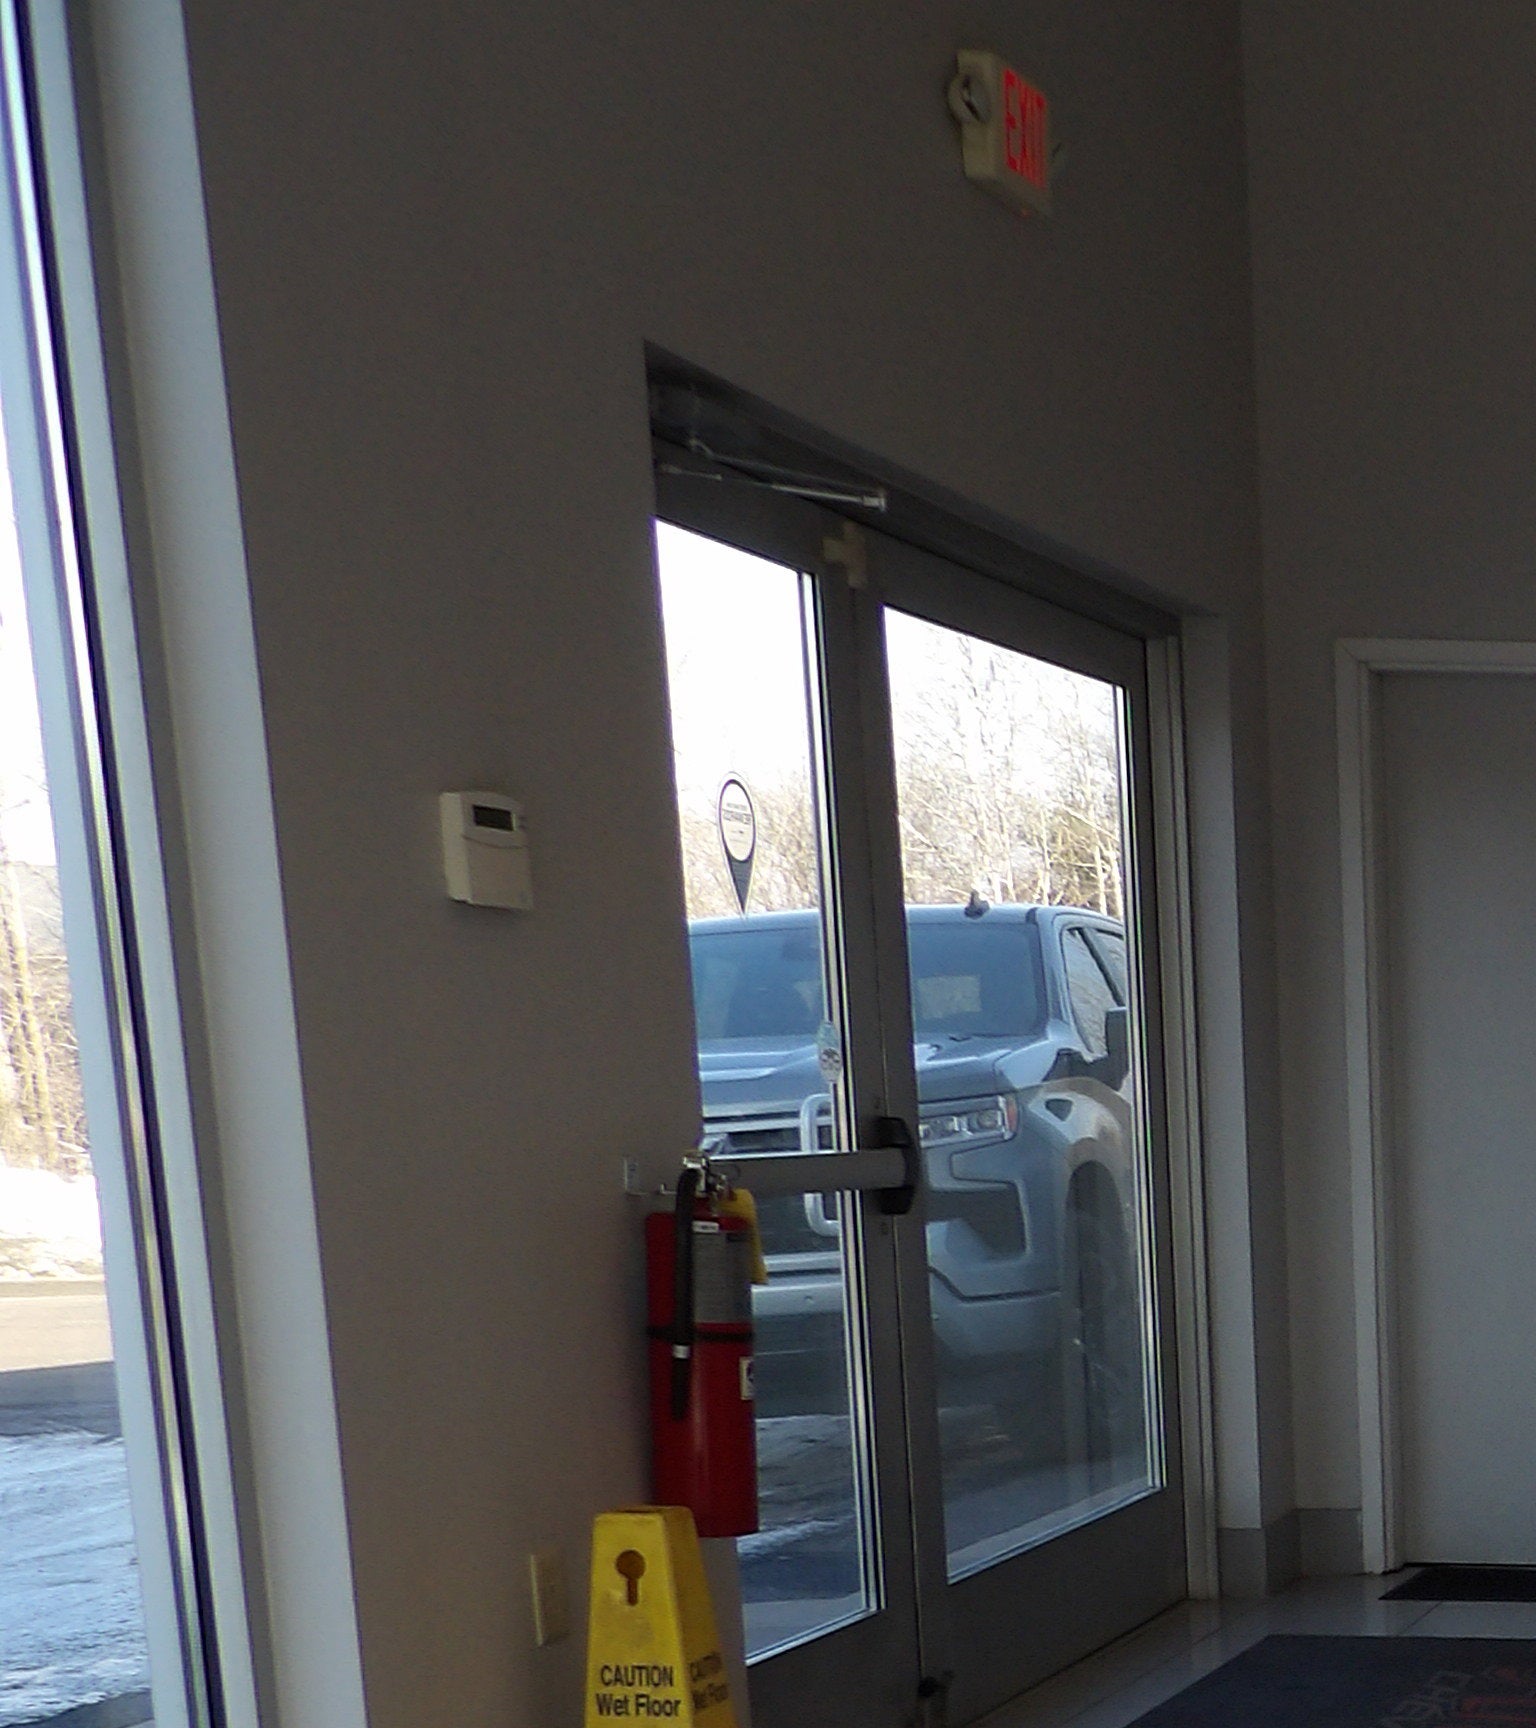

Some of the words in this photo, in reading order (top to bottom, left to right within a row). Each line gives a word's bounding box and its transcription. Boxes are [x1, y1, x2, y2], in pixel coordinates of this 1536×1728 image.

[600, 1664, 674, 1688] CAUTION
[596, 1692, 631, 1717] Wet
[634, 1692, 682, 1718] Floor
